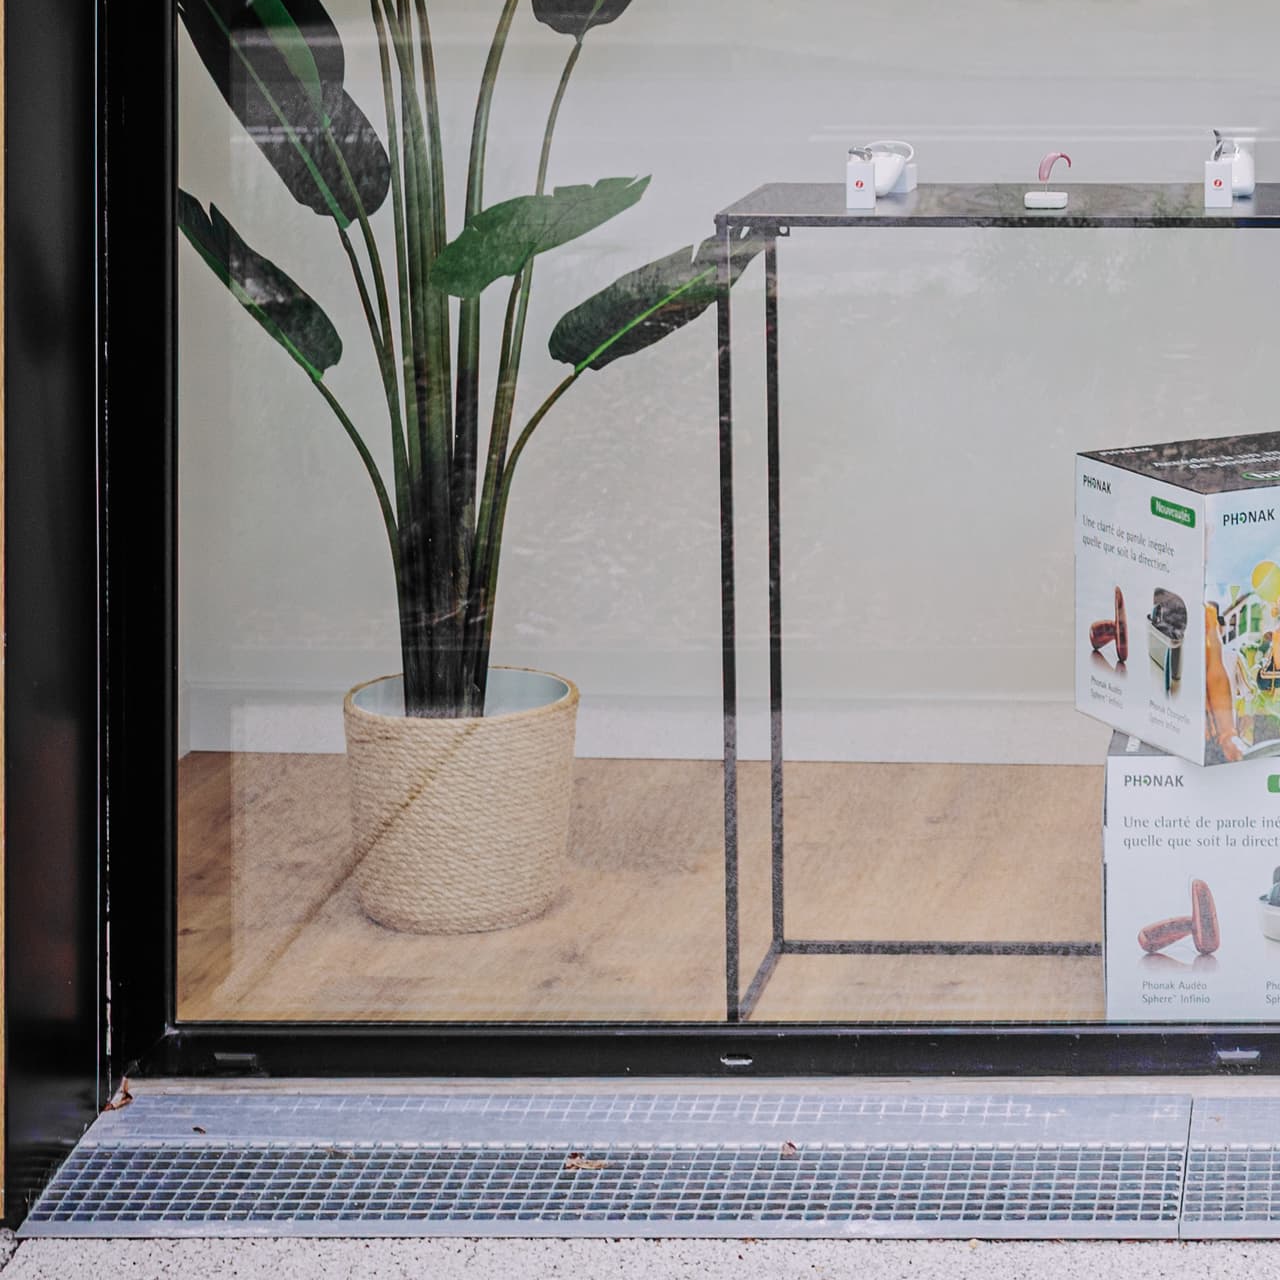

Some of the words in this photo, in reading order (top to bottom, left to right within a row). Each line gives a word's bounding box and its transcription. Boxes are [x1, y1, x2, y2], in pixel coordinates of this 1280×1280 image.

[1082, 474, 1112, 495] PHONAK
[1222, 507, 1276, 527] PHONAK
[1123, 774, 1184, 788] PHONAK
[1123, 816, 1149, 829] Une
[1154, 815, 1190, 829] clarté
[1195, 815, 1211, 829] de
[1216, 815, 1257, 832] parole
[1123, 834, 1163, 850] quelle
[1167, 837, 1192, 850] que
[1196, 834, 1221, 847] soit
[1225, 834, 1237, 847] la
[1142, 980, 1175, 991] Phonak
[1180, 993, 1211, 1005] Infinio
